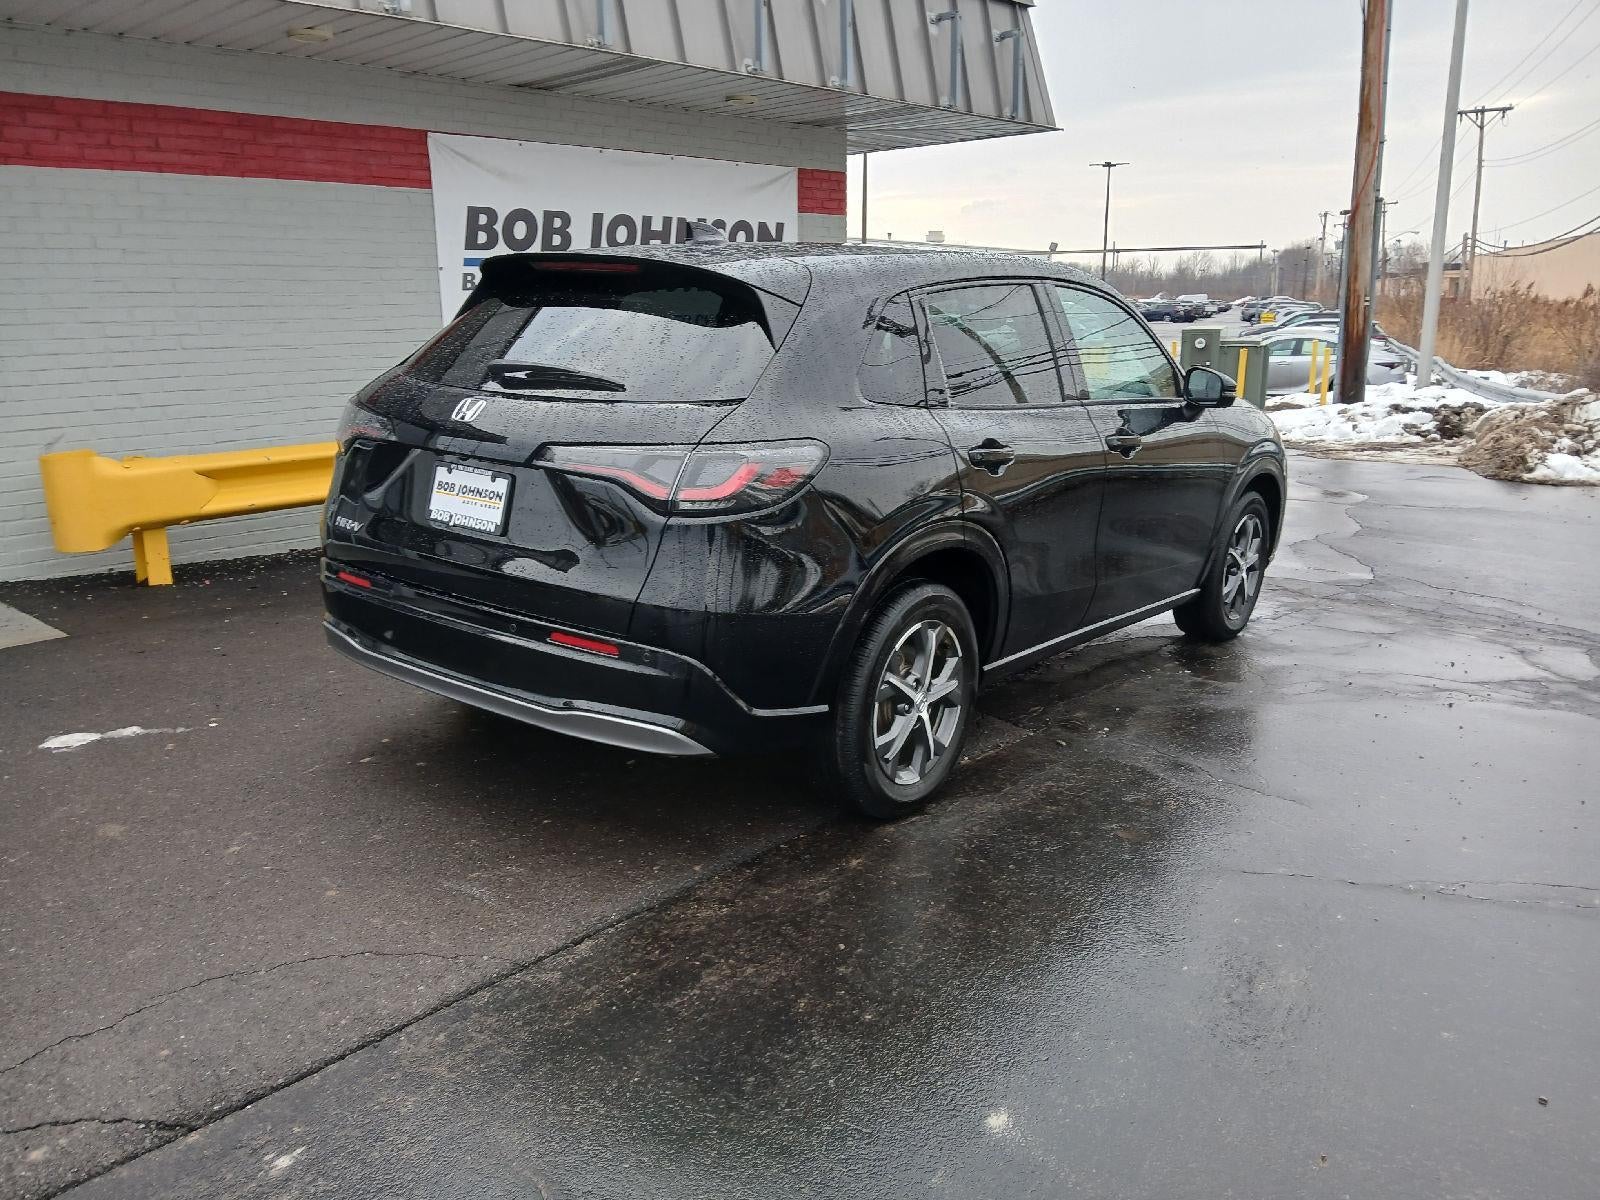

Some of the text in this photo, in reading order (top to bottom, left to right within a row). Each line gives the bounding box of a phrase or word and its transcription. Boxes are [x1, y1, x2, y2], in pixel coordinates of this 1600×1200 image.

[464, 205, 572, 252] BOB
[436, 480, 504, 502] BOB JOHNSON
[429, 509, 497, 532] BOB JOHNSON
